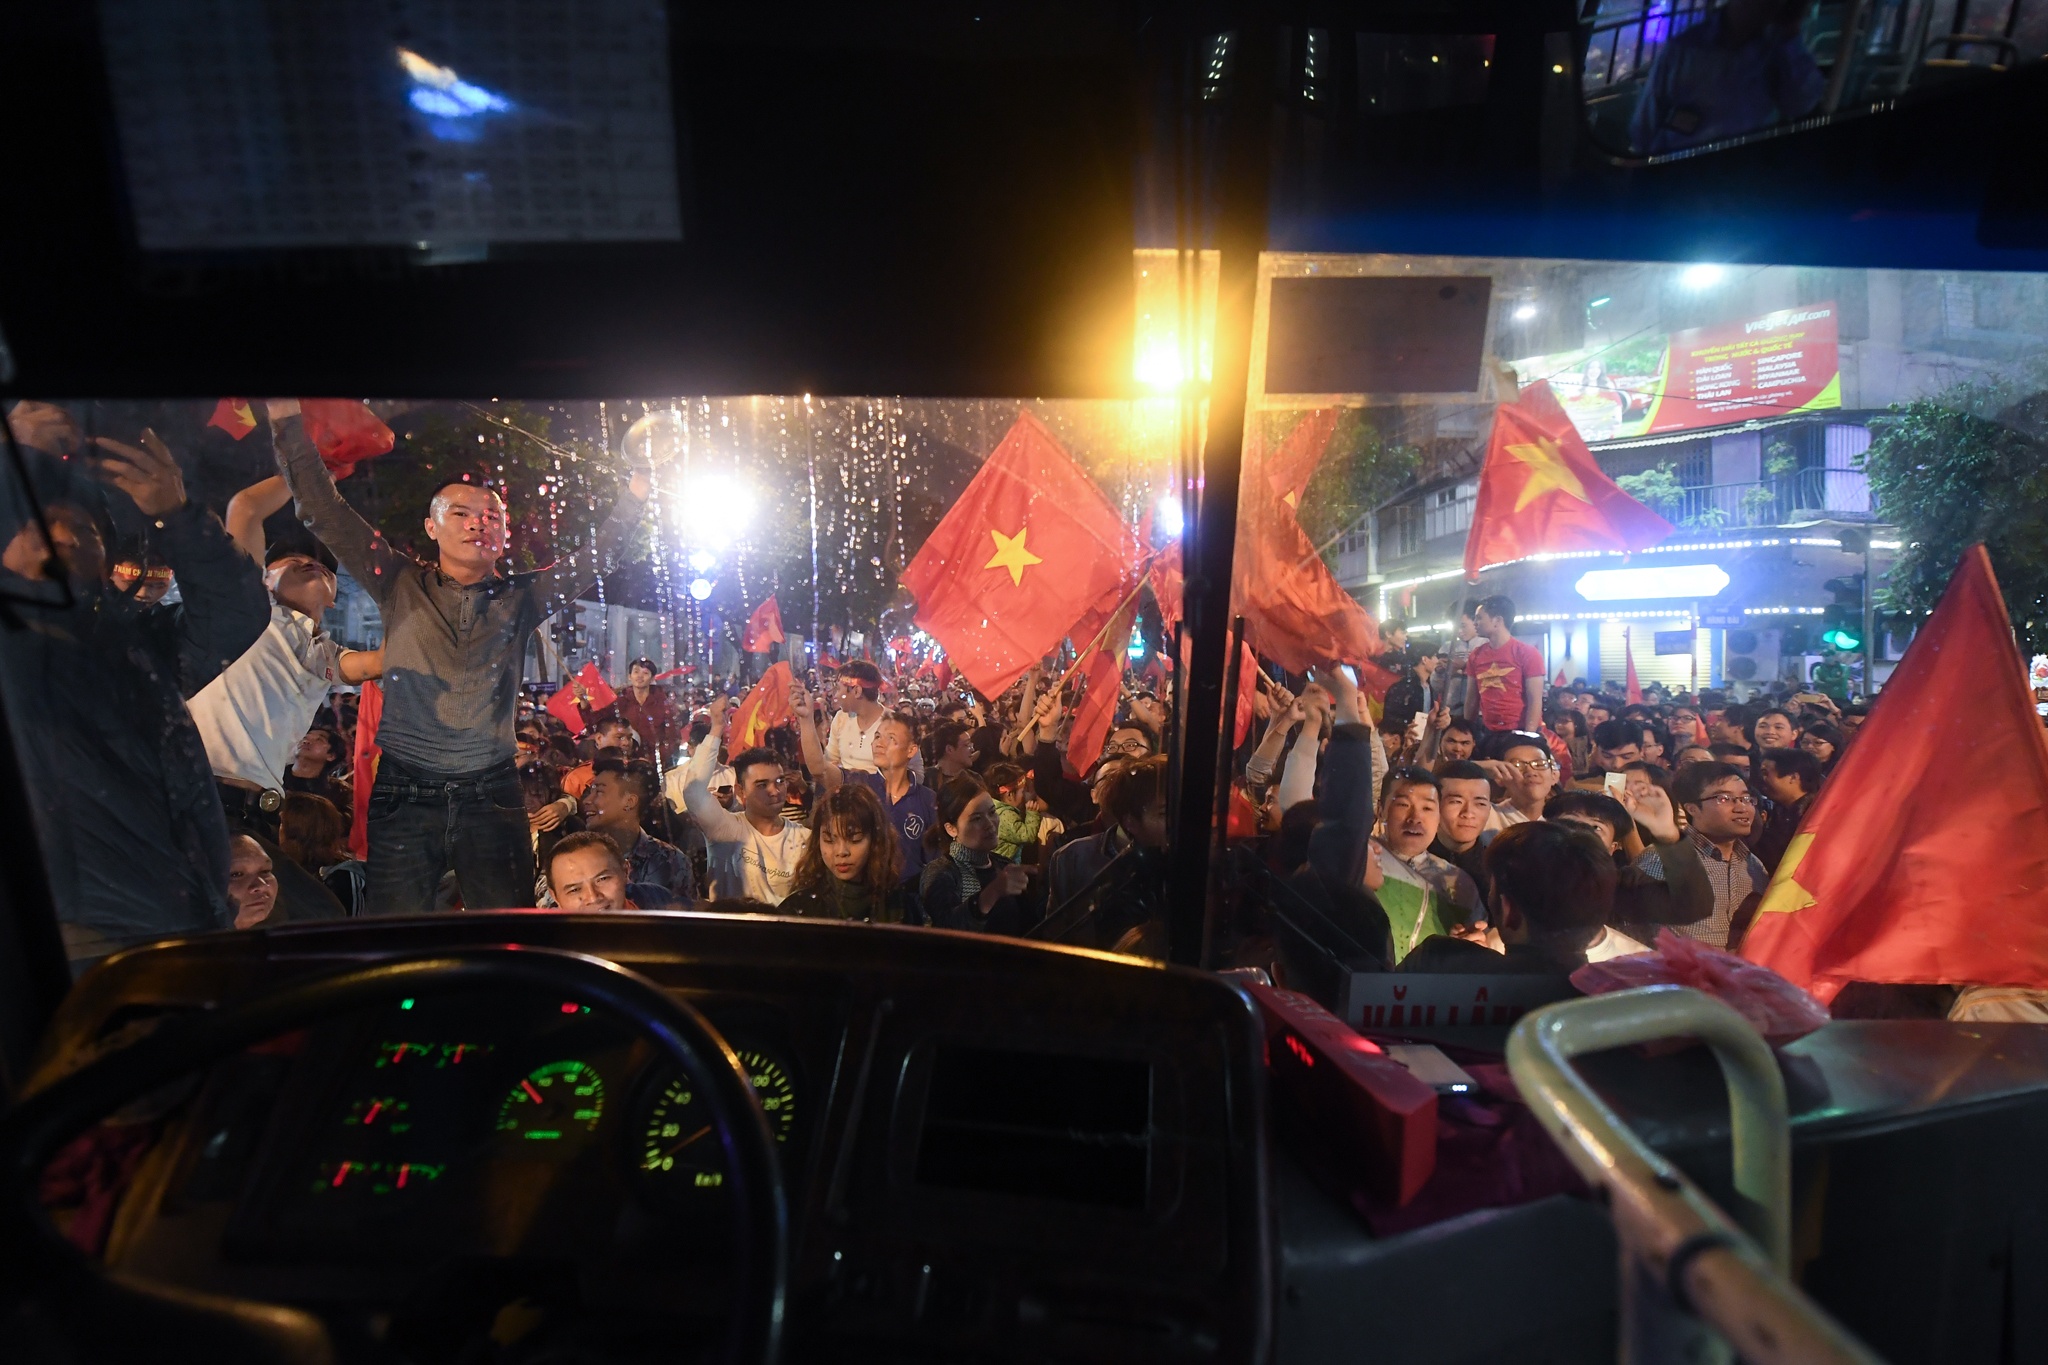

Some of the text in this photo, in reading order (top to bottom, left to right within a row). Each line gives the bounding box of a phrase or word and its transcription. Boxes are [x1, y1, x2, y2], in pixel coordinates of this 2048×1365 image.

[1757, 351, 1803, 365] SINGAPORE
[1695, 366, 1712, 375] HÀN
[1757, 361, 1797, 373] MALAYSIA
[1710, 372, 1732, 381] LOAN
[1757, 368, 1800, 381] MYANMAR
[1757, 375, 1807, 389] CAMPUCHIA
[1696, 389, 1732, 400] THÁI LAN
[906, 817, 920, 836] 20
[661, 1123, 680, 1137] 20
[662, 1156, 674, 1171] 0
